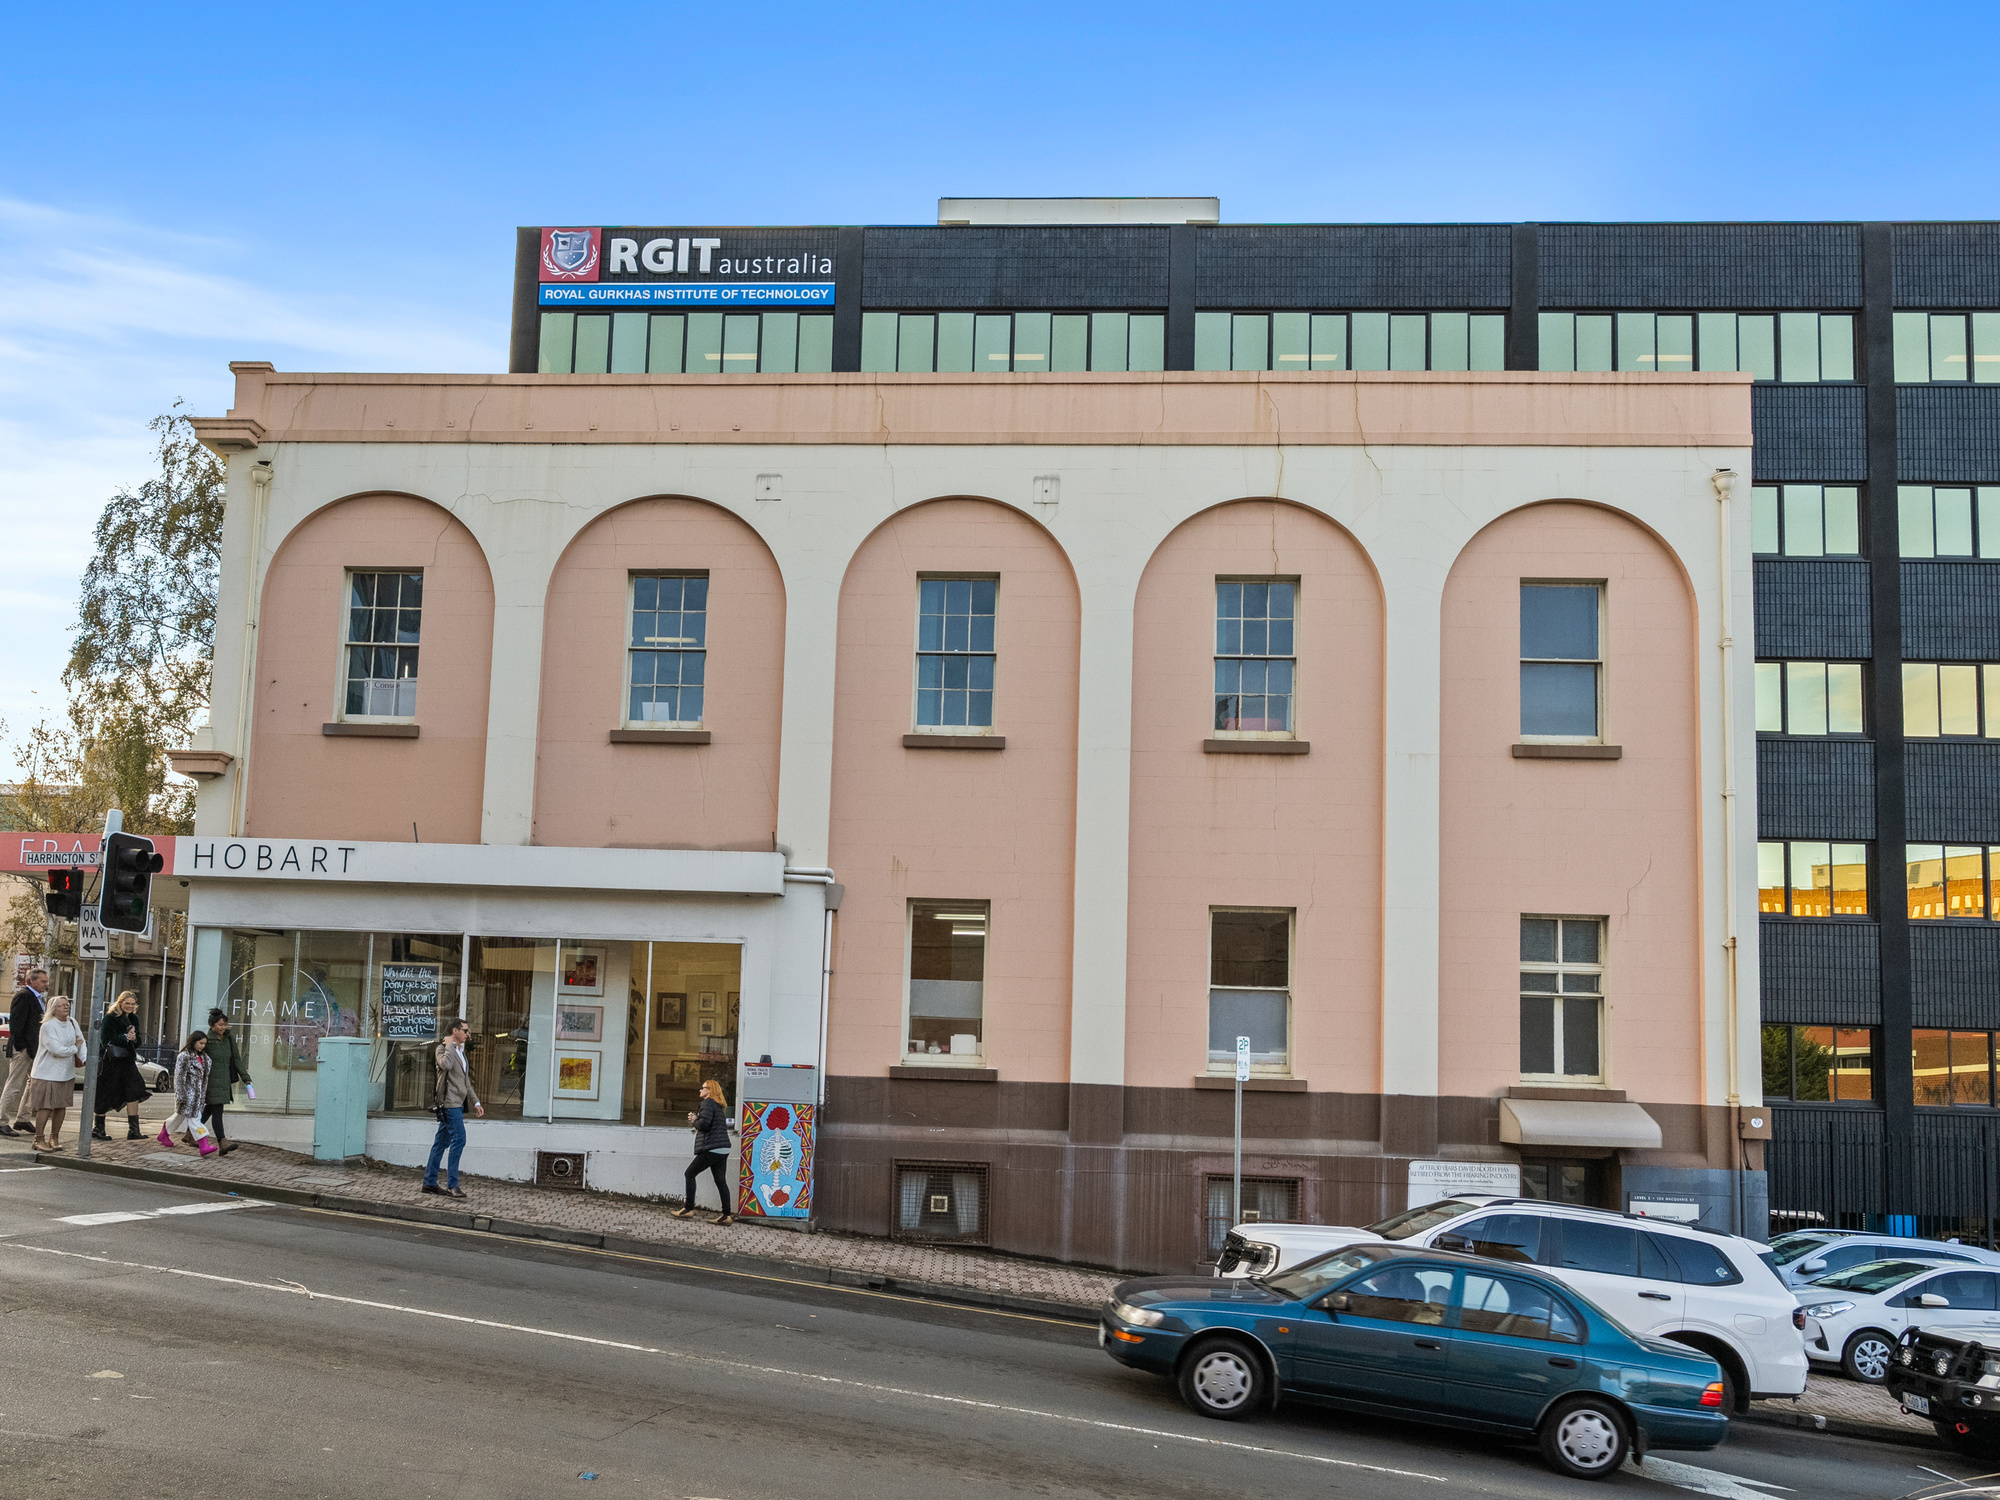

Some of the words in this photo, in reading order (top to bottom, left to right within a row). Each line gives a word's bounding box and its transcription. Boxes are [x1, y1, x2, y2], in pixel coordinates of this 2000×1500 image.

[609, 238, 721, 275] RGIT
[719, 252, 832, 274] australia
[545, 289, 585, 299] ROYAL
[588, 289, 651, 299] GURKHAS
[654, 289, 718, 299] INSTITUTE
[721, 289, 739, 299] OF
[741, 289, 829, 299] TECHNOLOGY
[27, 852, 84, 864] HARRINGTON
[194, 843, 356, 873] HOBART
[83, 909, 98, 922] ON
[81, 926, 105, 939] WAY
[383, 967, 398, 981] Why
[400, 967, 414, 978] did
[419, 967, 433, 978] the
[405, 981, 419, 993] get
[383, 993, 391, 1004] to
[393, 993, 406, 1002] his
[408, 992, 436, 1004] room?
[232, 998, 315, 1018] FRAME
[388, 1024, 424, 1035] around!
[235, 1033, 308, 1046] HOBART
[1238, 1039, 1249, 1051] 2P
